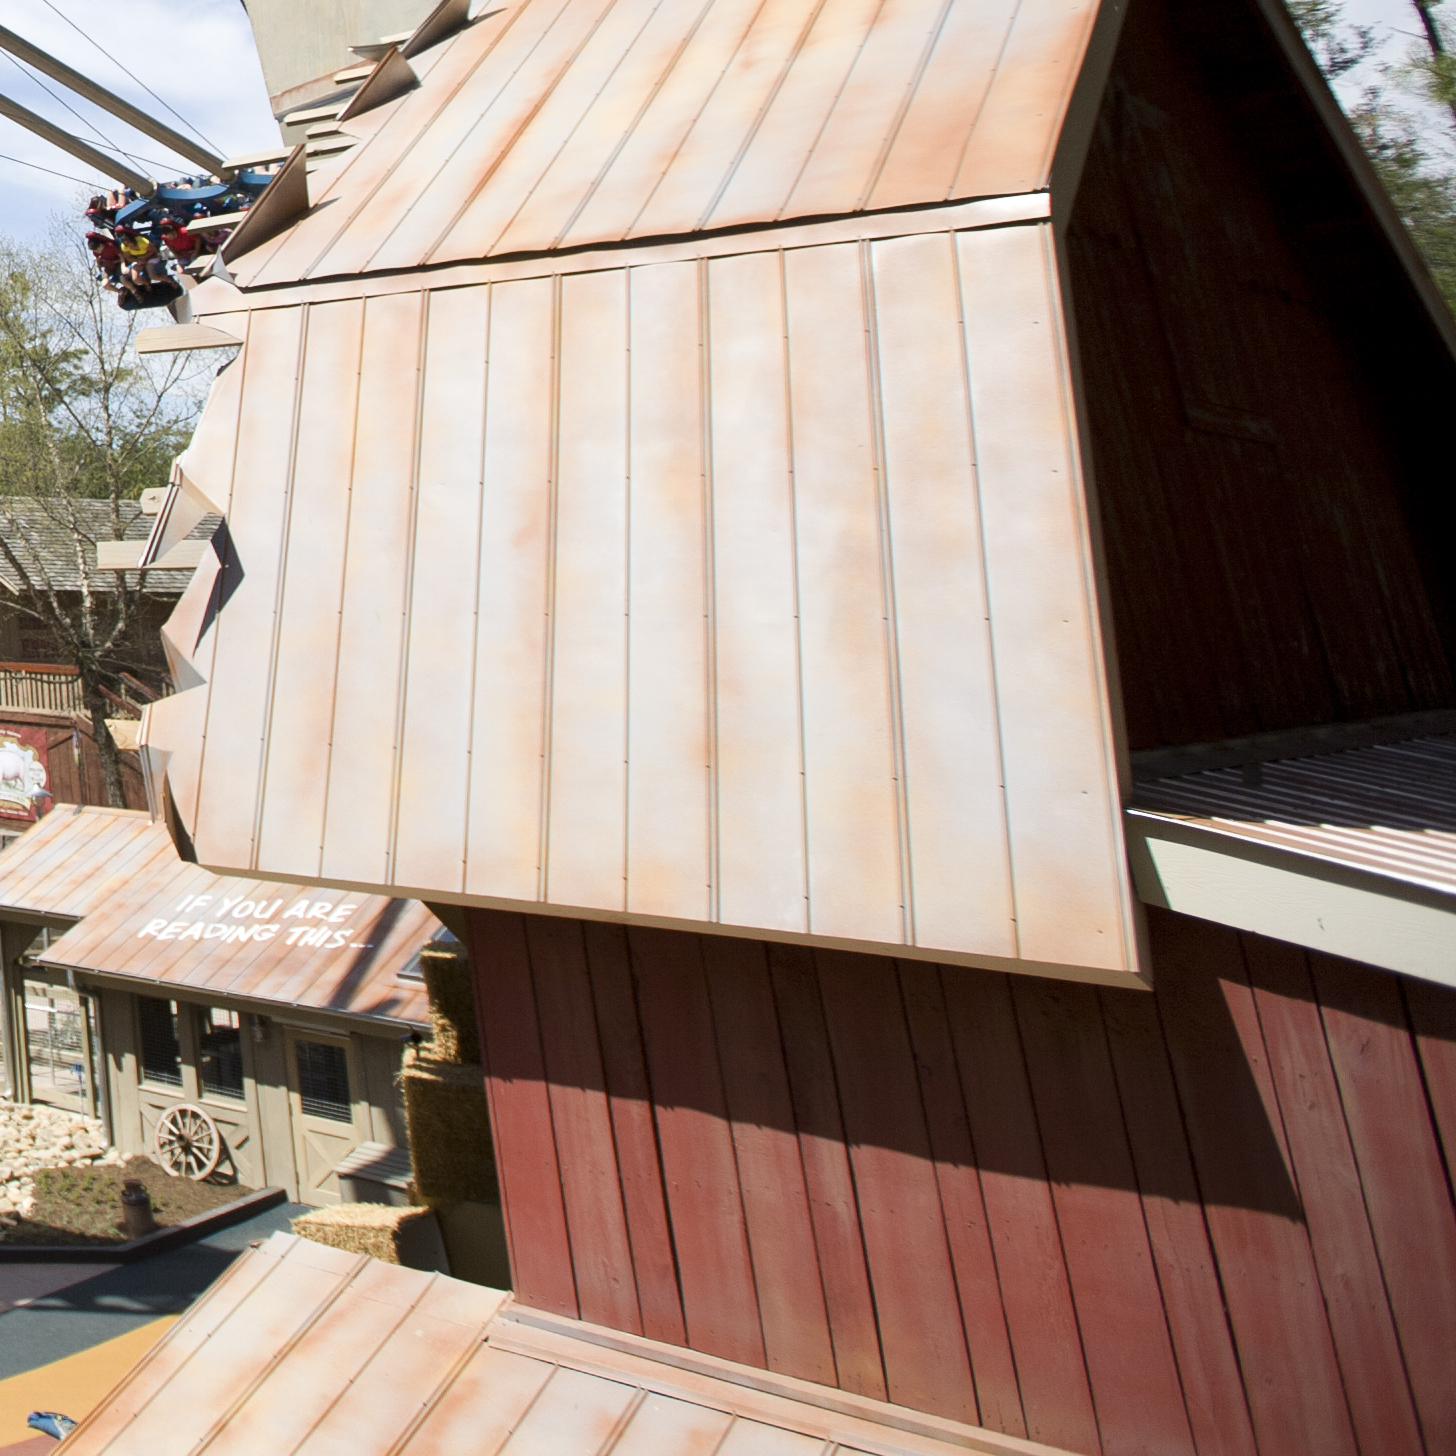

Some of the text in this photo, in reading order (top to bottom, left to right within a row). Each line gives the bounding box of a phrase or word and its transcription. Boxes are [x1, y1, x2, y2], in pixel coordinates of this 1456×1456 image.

[175, 894, 358, 923] IF YOU ARE
[137, 918, 281, 944] READING
